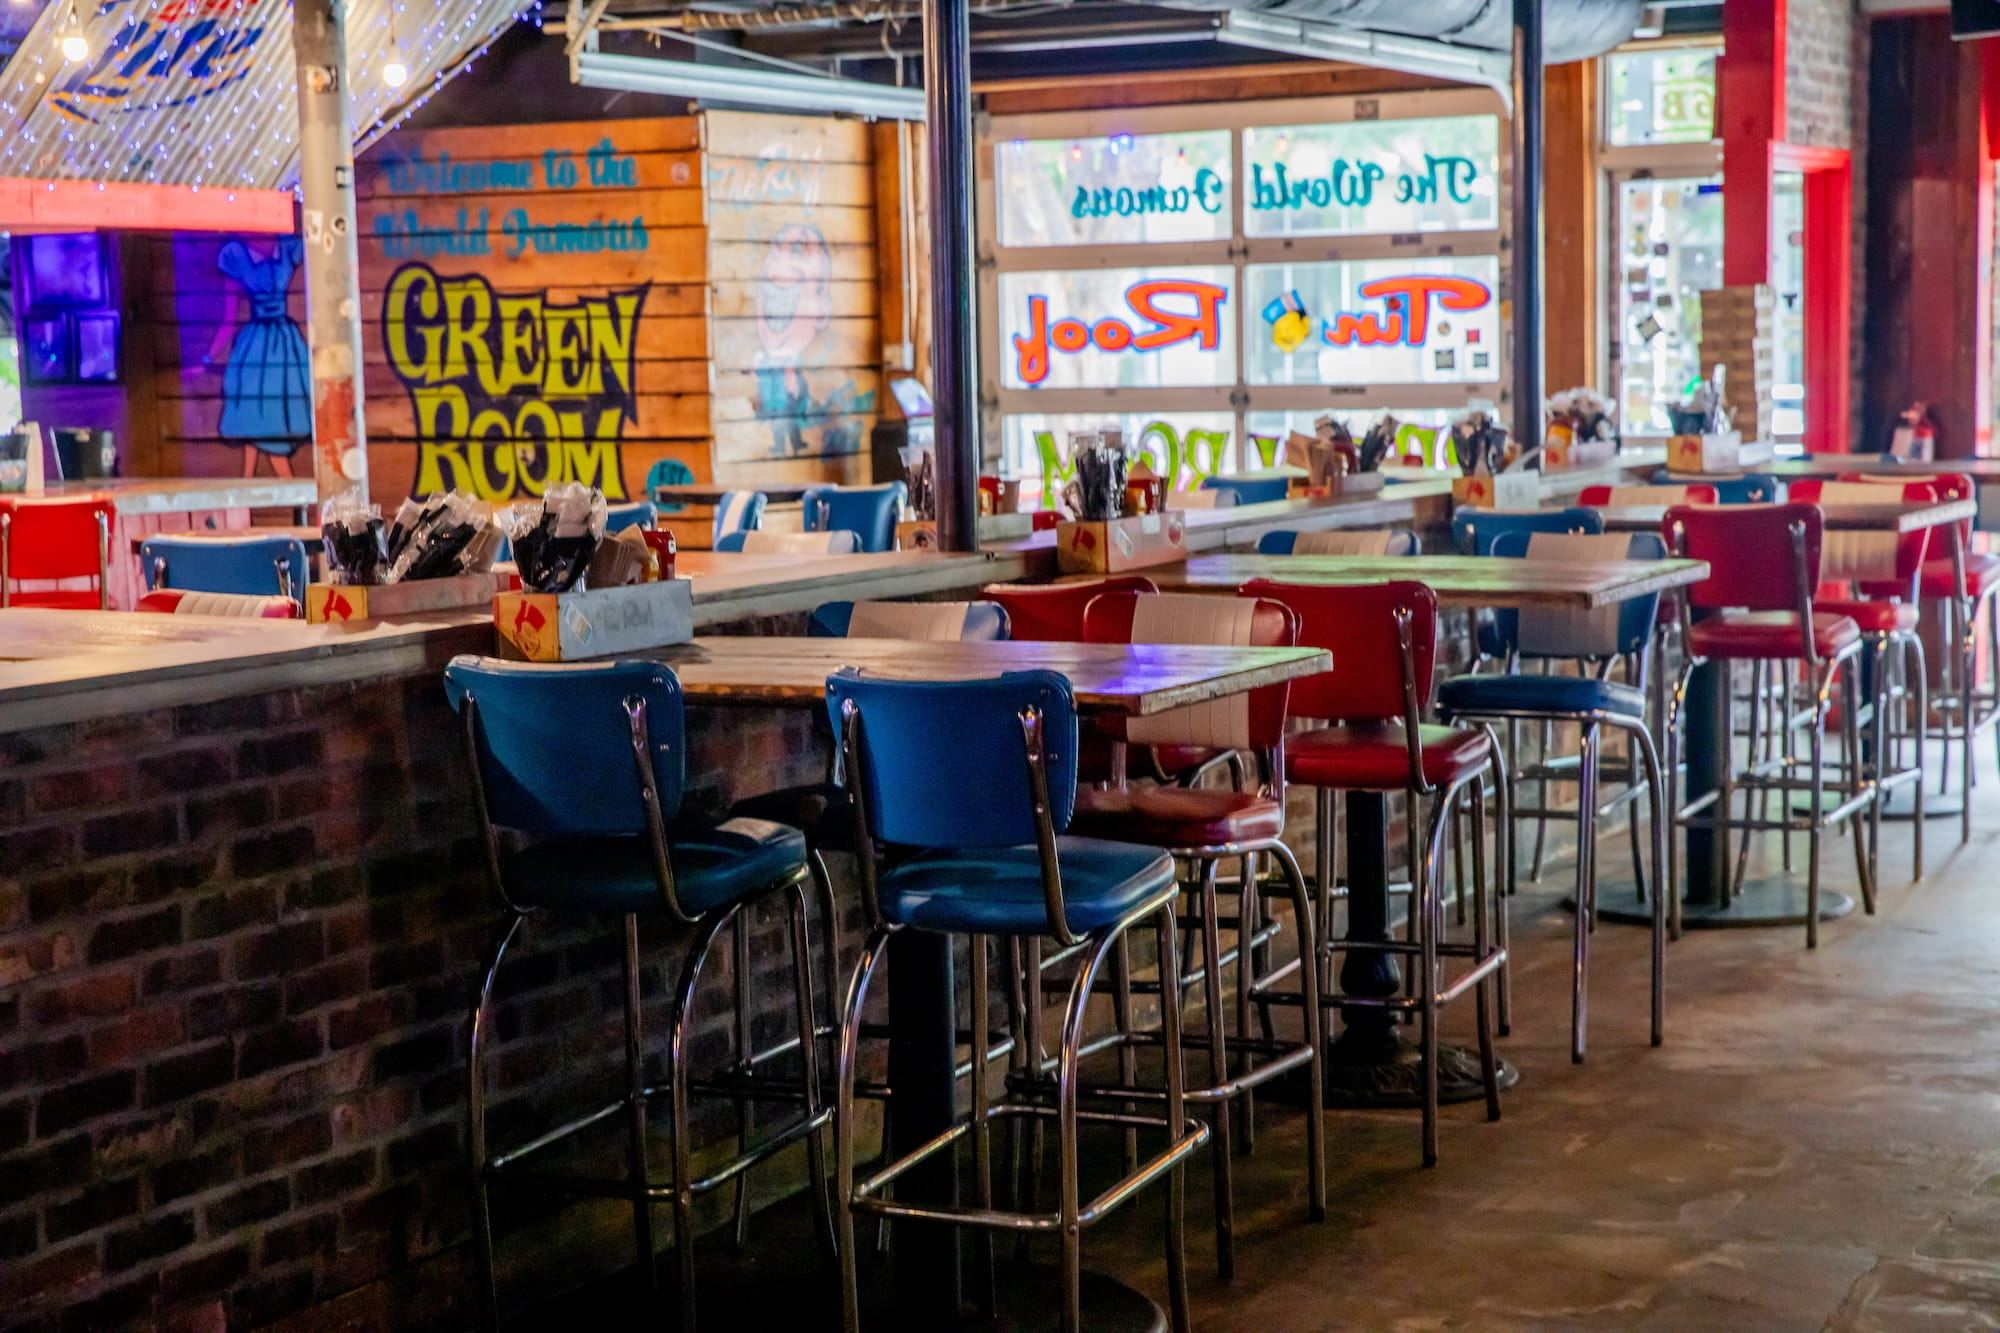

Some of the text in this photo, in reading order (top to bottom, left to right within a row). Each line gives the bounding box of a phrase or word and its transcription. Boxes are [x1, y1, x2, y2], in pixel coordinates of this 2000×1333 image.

[379, 137, 640, 194] Welcome to the
[373, 207, 648, 259] World Famous
[384, 263, 648, 398] GREEN
[414, 384, 628, 503] ROOM
